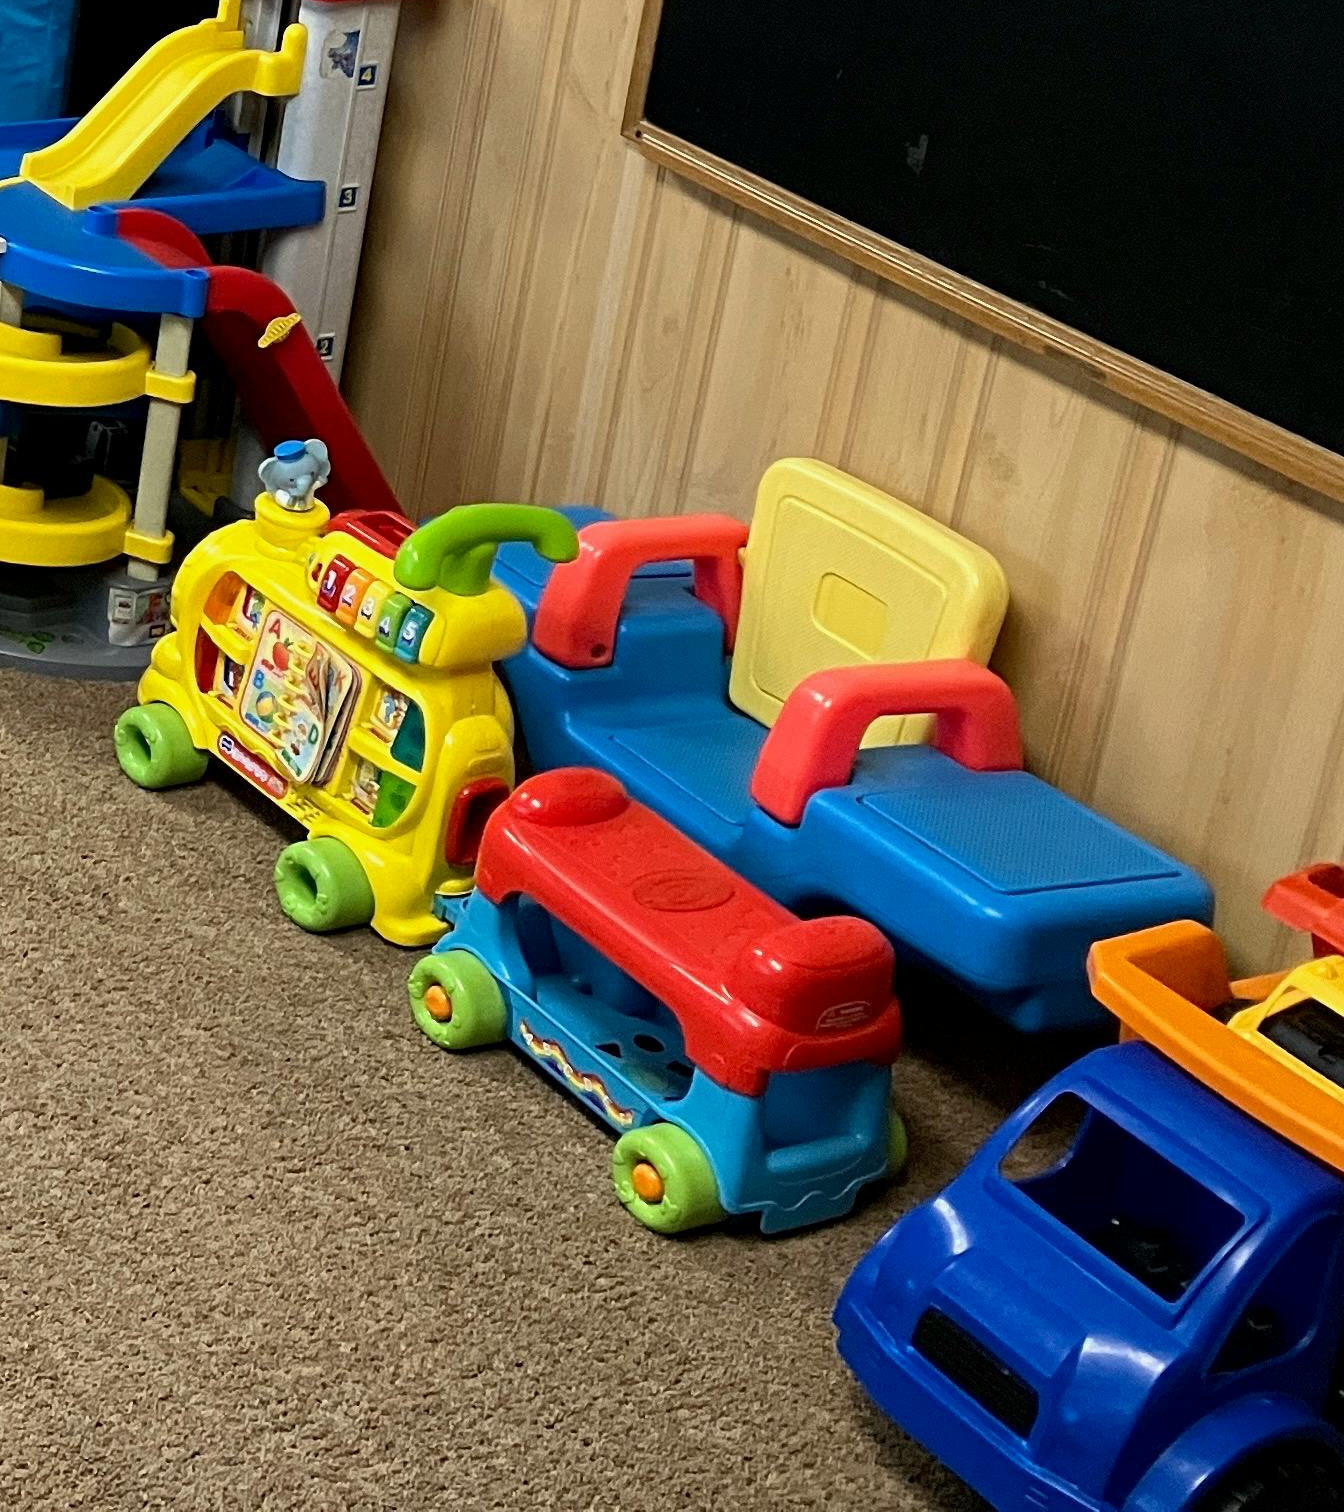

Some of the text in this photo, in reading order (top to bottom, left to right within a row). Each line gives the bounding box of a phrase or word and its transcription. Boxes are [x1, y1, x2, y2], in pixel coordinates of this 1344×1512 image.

[361, 65, 372, 81] 4
[342, 188, 353, 204] 3
[326, 570, 418, 647] 1 2 3 4 5
[268, 618, 281, 636] A
[253, 669, 265, 688] B
